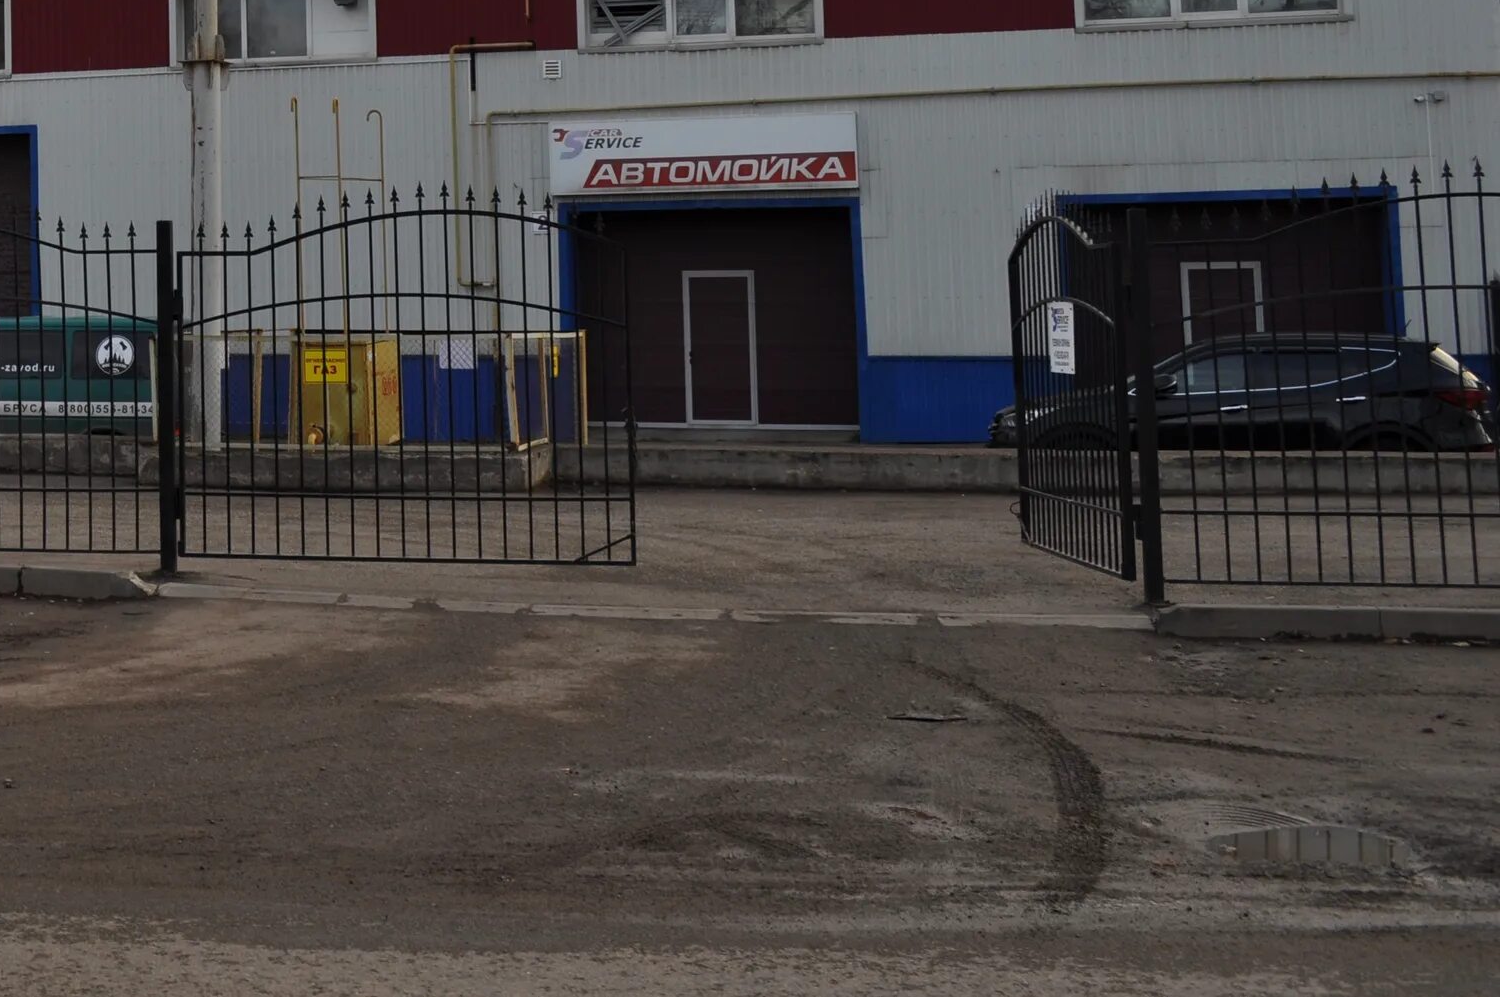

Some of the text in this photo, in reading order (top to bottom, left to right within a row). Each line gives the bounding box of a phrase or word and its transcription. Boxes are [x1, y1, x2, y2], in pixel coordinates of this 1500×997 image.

[590, 129, 619, 138] CAR
[590, 155, 847, 186] АВТОМОЙКА
[314, 365, 337, 375] ГАЗ
[3, 404, 47, 413] БРУСА
